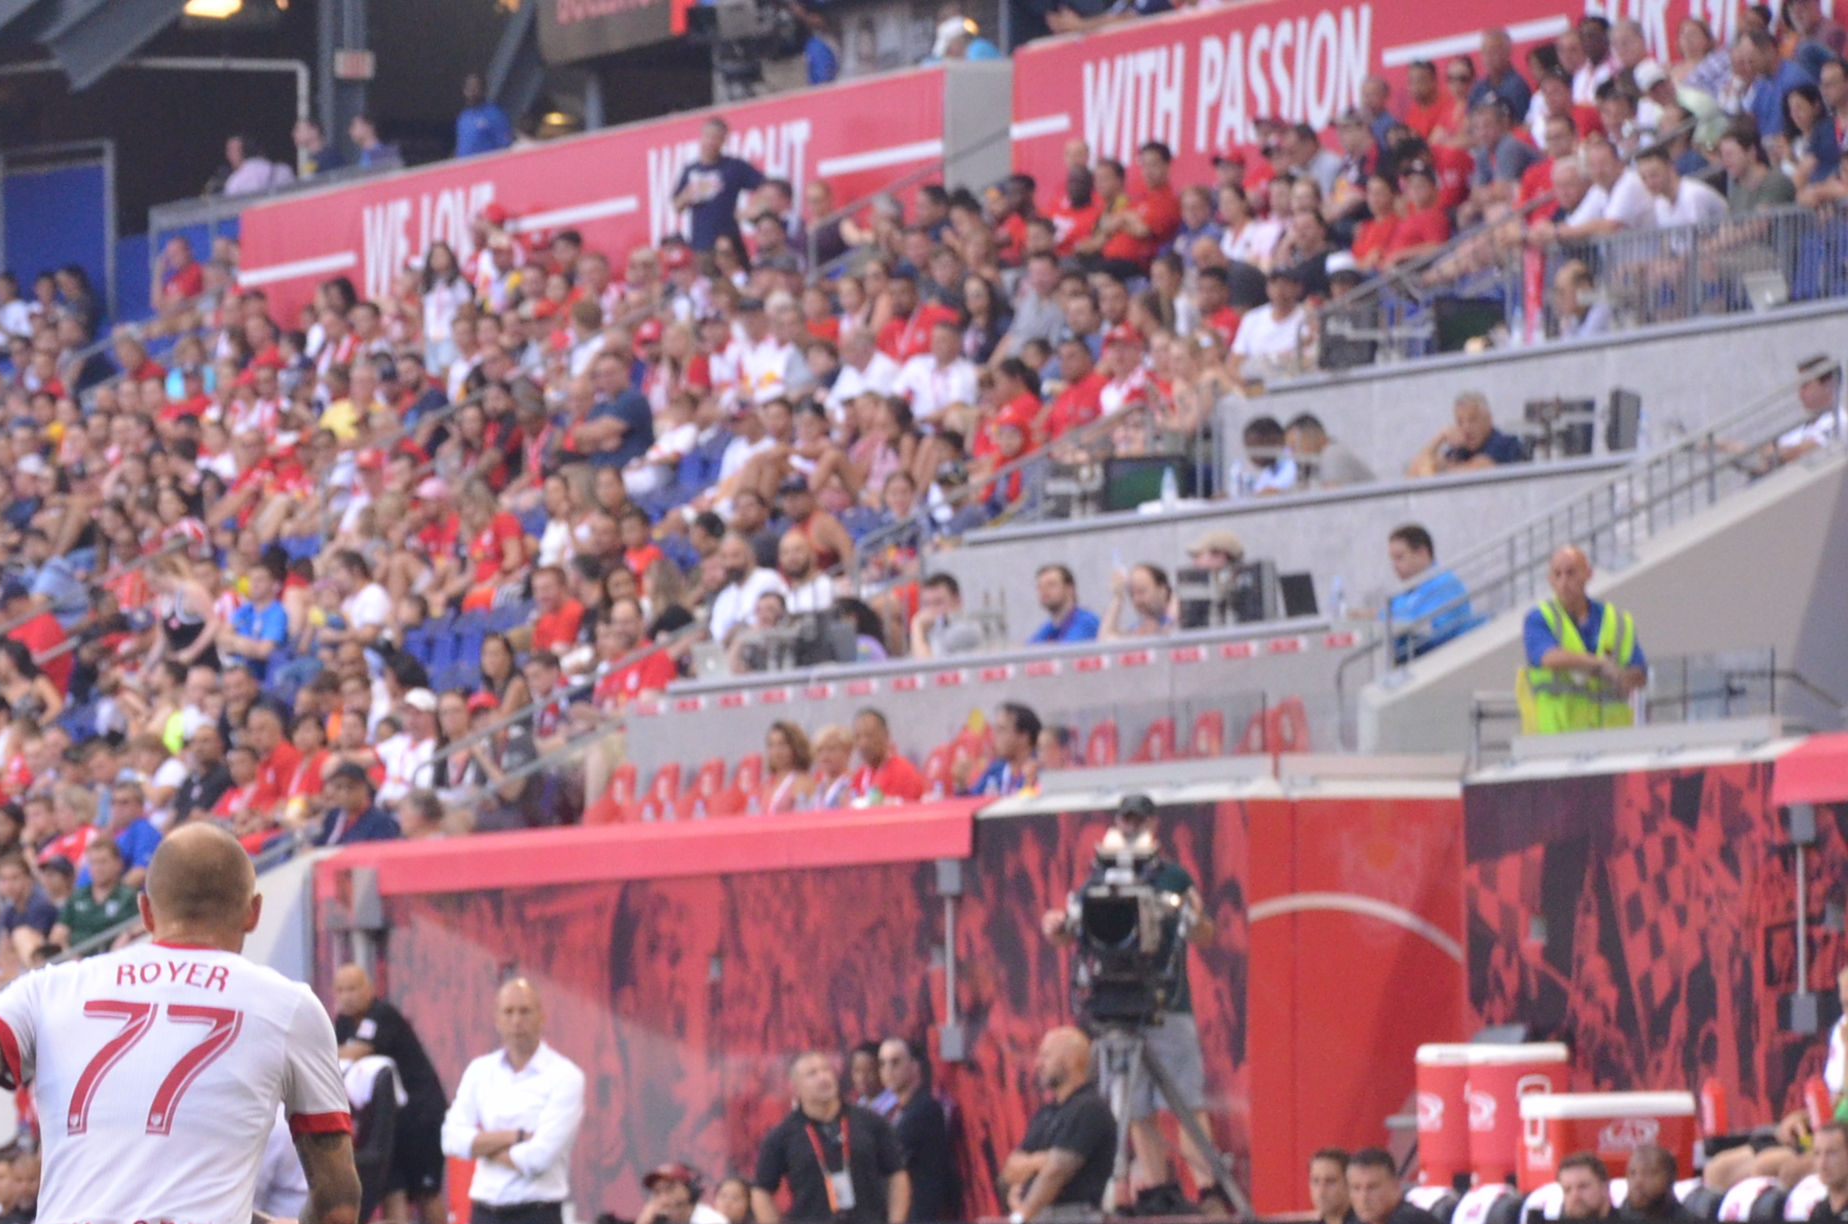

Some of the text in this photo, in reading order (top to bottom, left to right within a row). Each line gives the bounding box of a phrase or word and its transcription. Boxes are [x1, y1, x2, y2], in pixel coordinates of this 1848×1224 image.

[1082, 4, 1372, 170] WITH PASSION
[115, 961, 230, 992] ROYER
[67, 999, 245, 1136] 77
